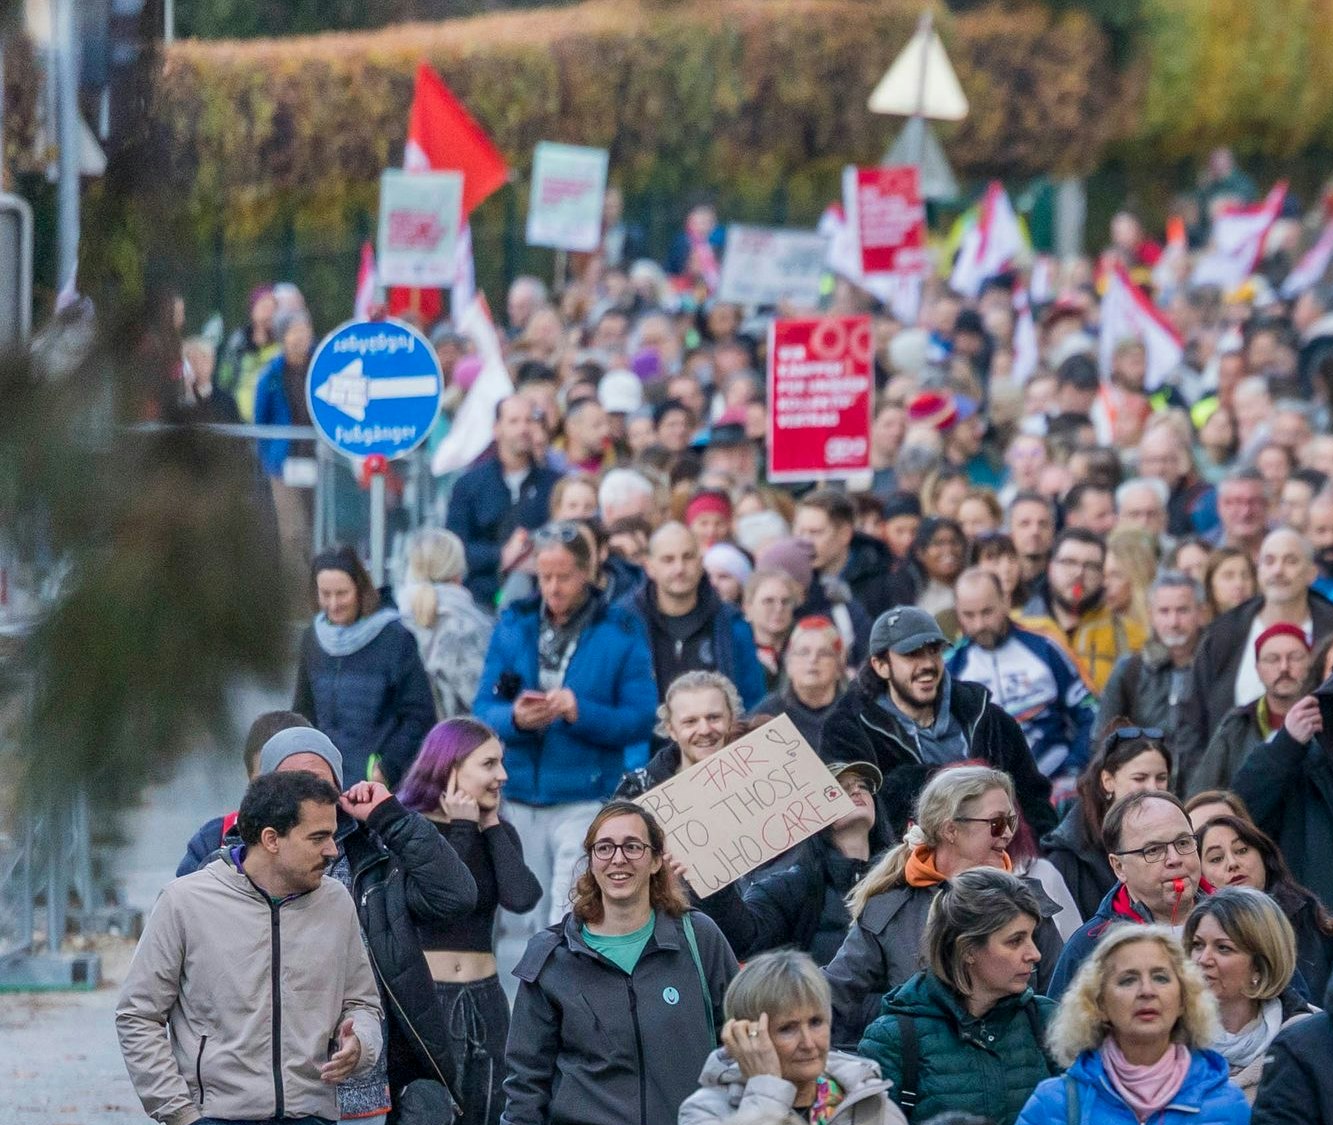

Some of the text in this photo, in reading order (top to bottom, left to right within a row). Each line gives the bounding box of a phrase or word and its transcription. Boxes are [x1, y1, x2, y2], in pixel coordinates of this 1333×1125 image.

[640, 745, 769, 824] BE FAIR
[666, 759, 810, 854] TO THOSE
[692, 791, 838, 890] WHO CARE
